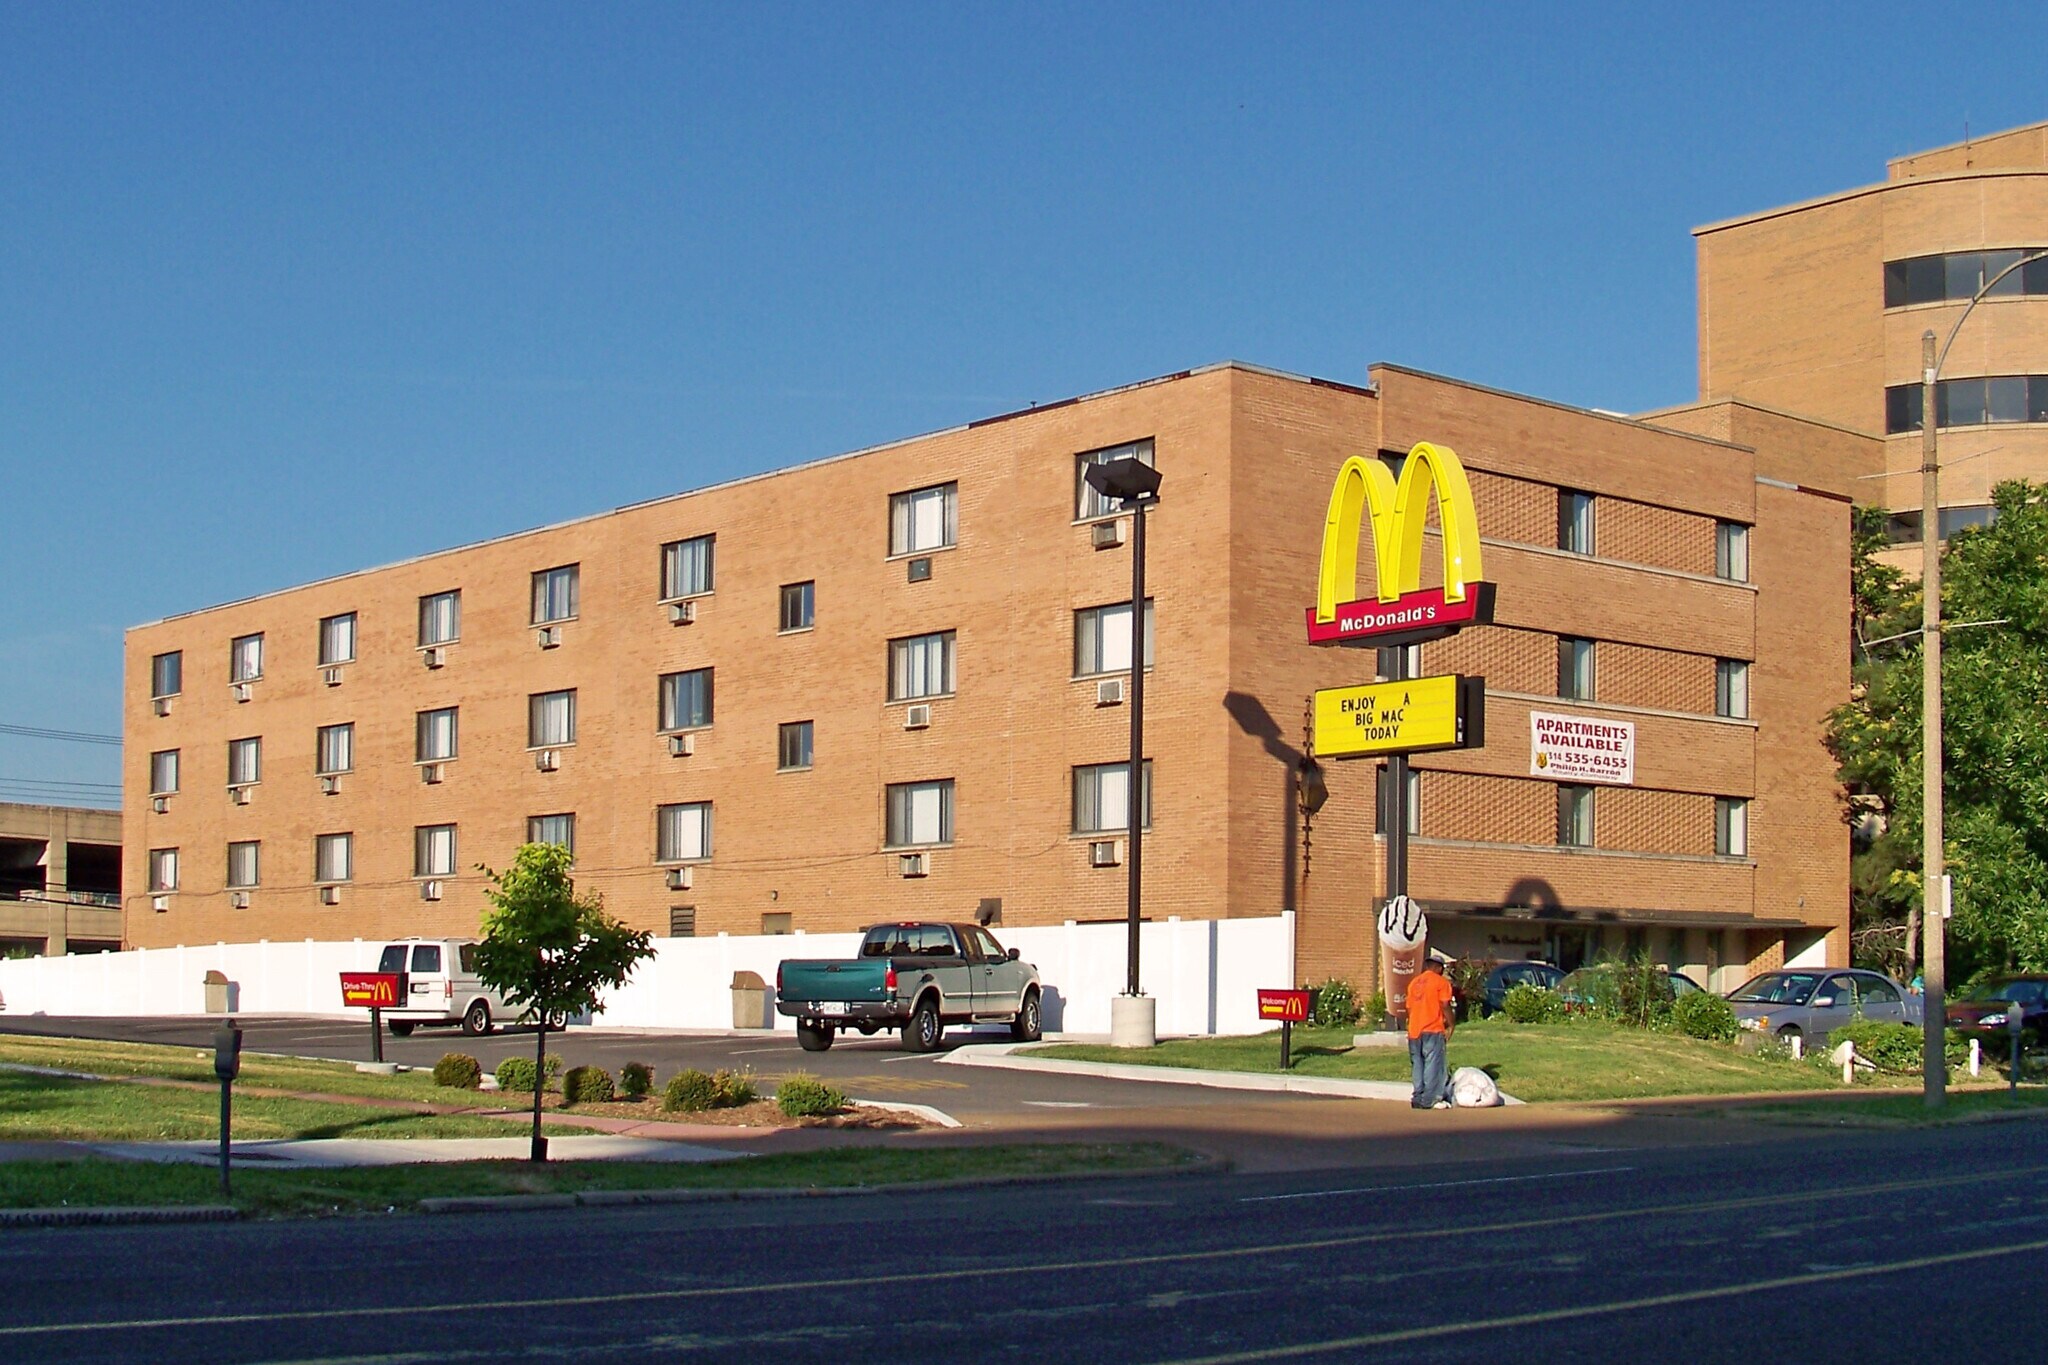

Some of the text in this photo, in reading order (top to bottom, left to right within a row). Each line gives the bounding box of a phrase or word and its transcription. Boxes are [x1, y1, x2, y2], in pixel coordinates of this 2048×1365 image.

[1340, 605, 1436, 632] McDonald's
[1341, 692, 1410, 712] ENJOY A
[1355, 708, 1404, 726] BIG MAC
[1364, 725, 1399, 741] TODAY
[1536, 718, 1628, 740] APARTMENTS
[1540, 733, 1623, 752] AVAILABLE
[1550, 762, 1578, 772] Philip
[1392, 957, 1414, 968] iced
